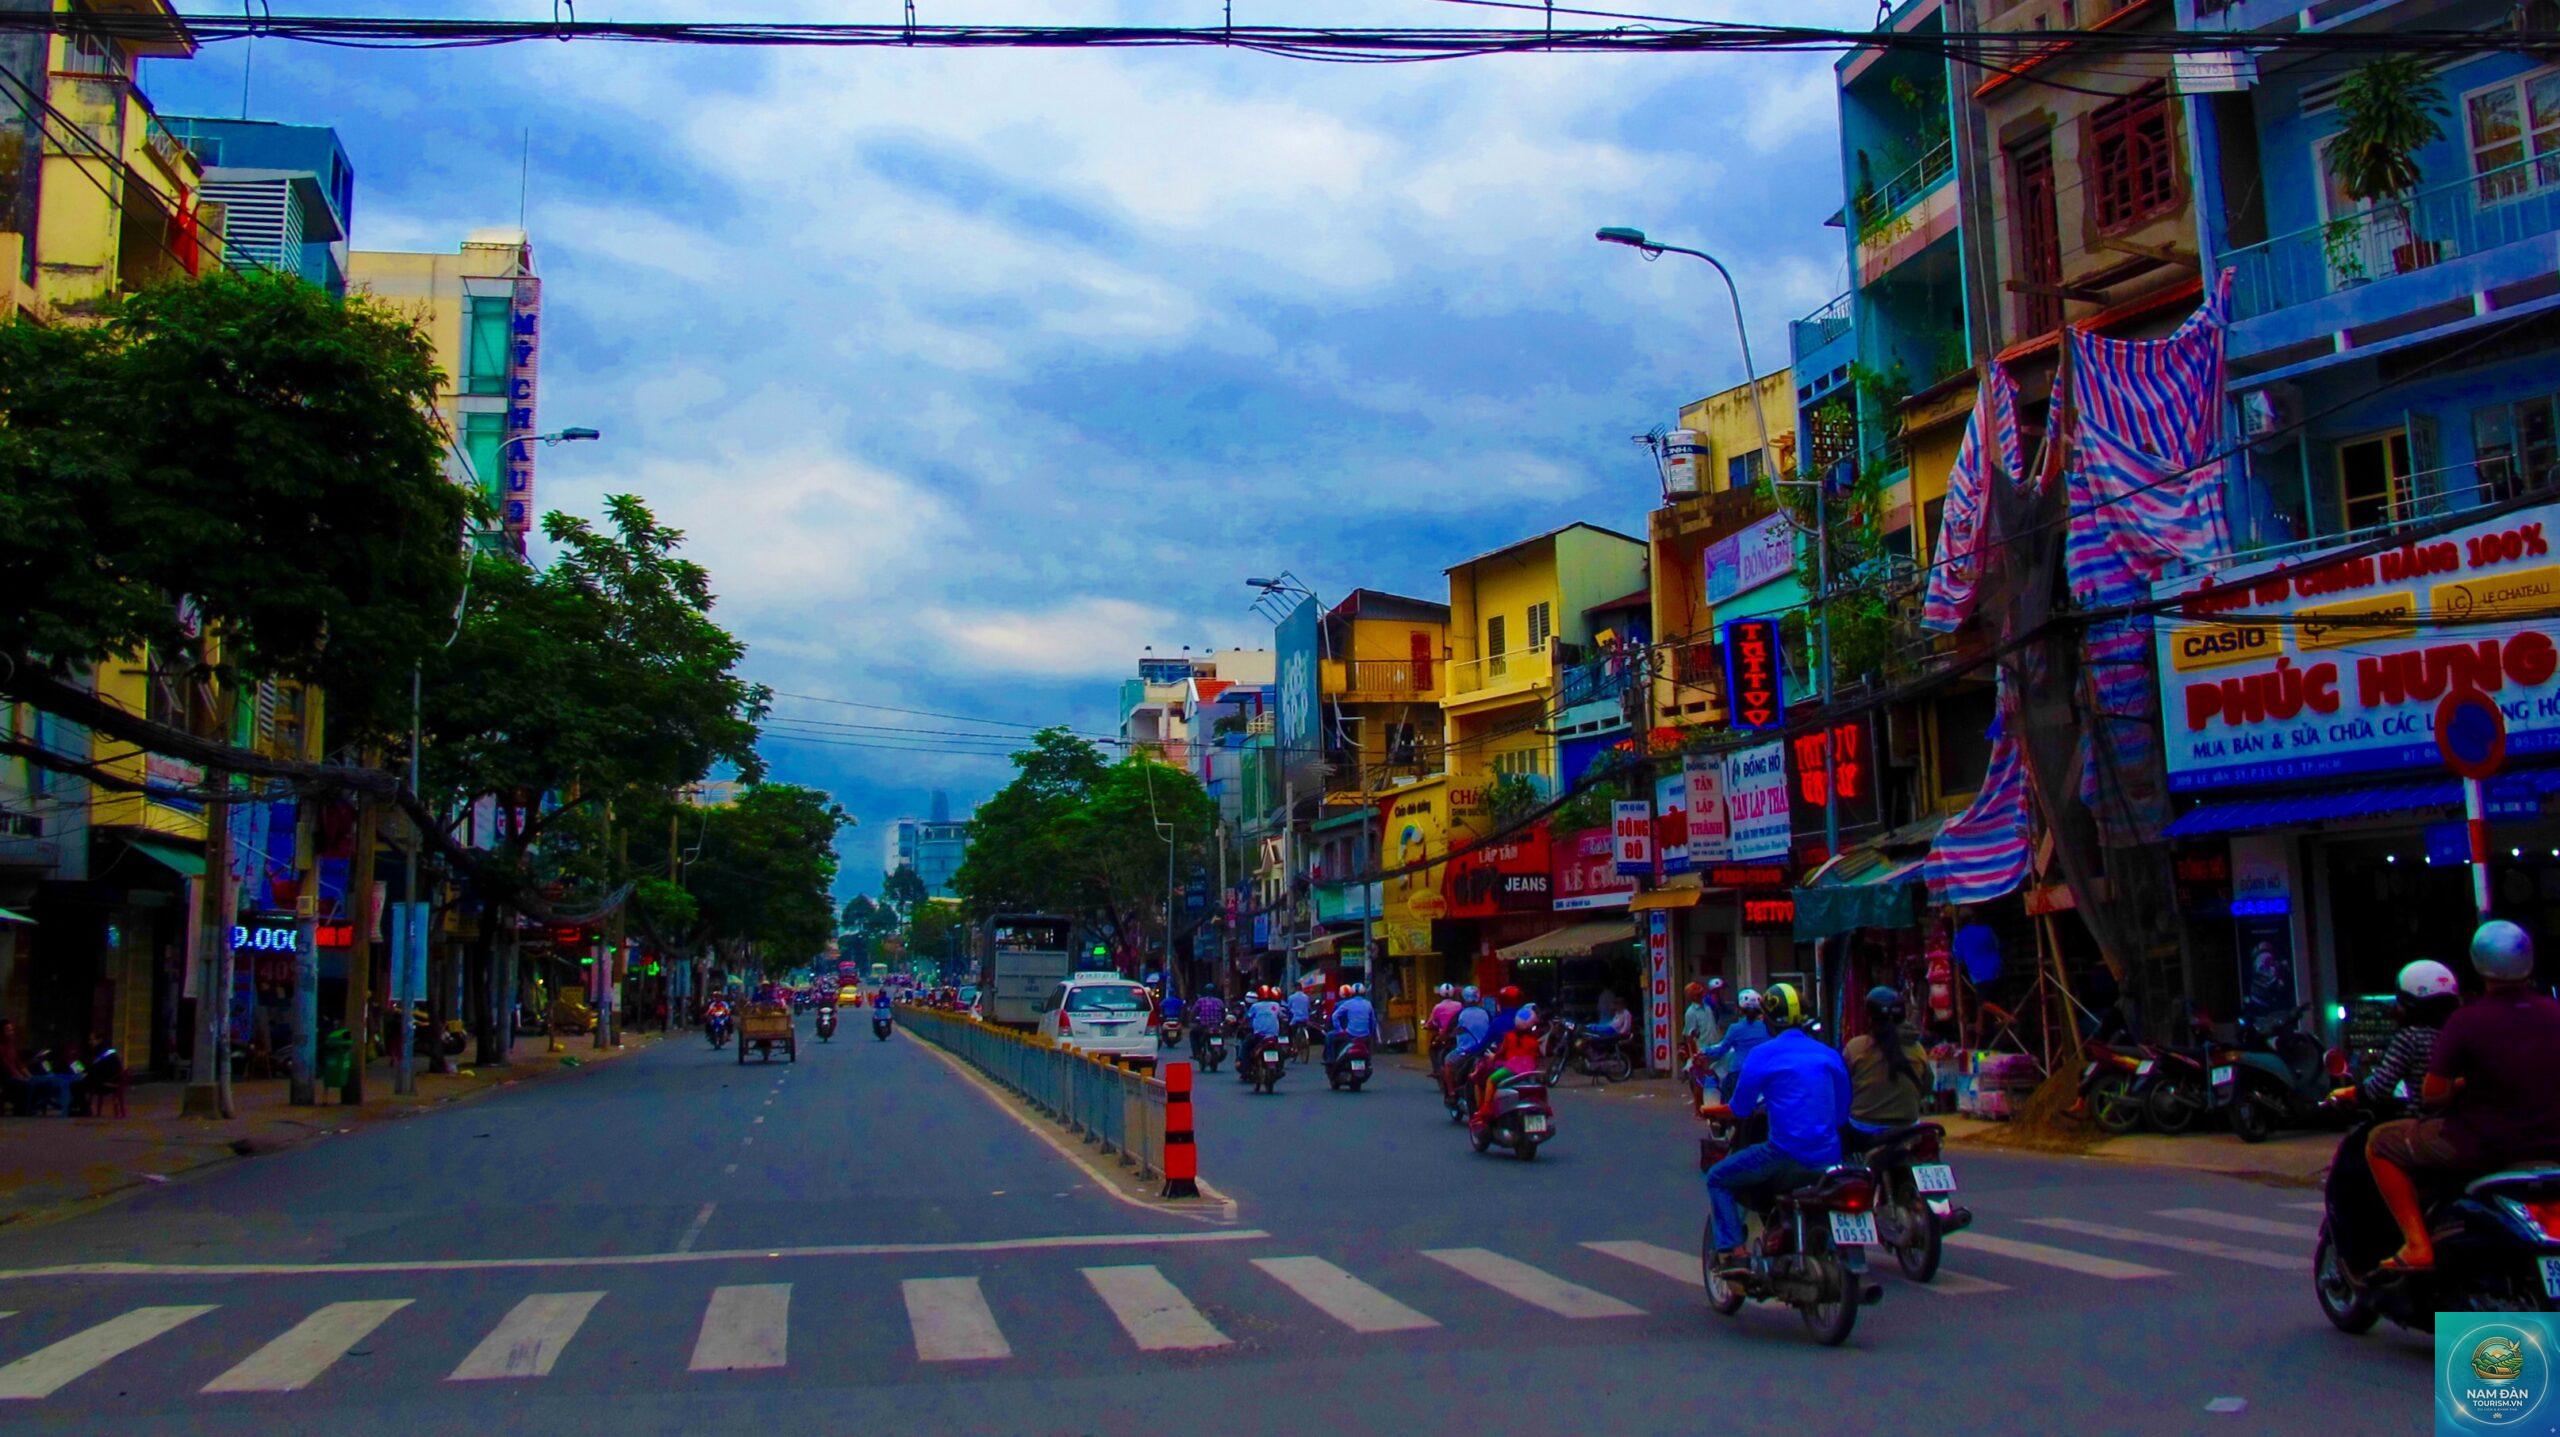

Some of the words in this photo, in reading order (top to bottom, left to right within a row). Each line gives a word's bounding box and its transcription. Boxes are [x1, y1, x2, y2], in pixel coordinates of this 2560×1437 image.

[2466, 521, 2548, 568] 100%
[2183, 627, 2267, 658] CASIO
[1739, 622, 1771, 727] TATTOO
[2186, 657, 2340, 732] PHÚC
[2193, 742, 2226, 760] MUA
[2232, 731, 2265, 754] BÁN
[2271, 733, 2284, 750] &
[2291, 721, 2321, 748] SỬA
[2328, 717, 2374, 743] CHỮA
[2383, 711, 2417, 736] CÁC
[1617, 817, 1649, 837] ĐÔNG
[1505, 876, 1547, 892] JEANS
[1655, 979, 1667, 1061] DUNG
